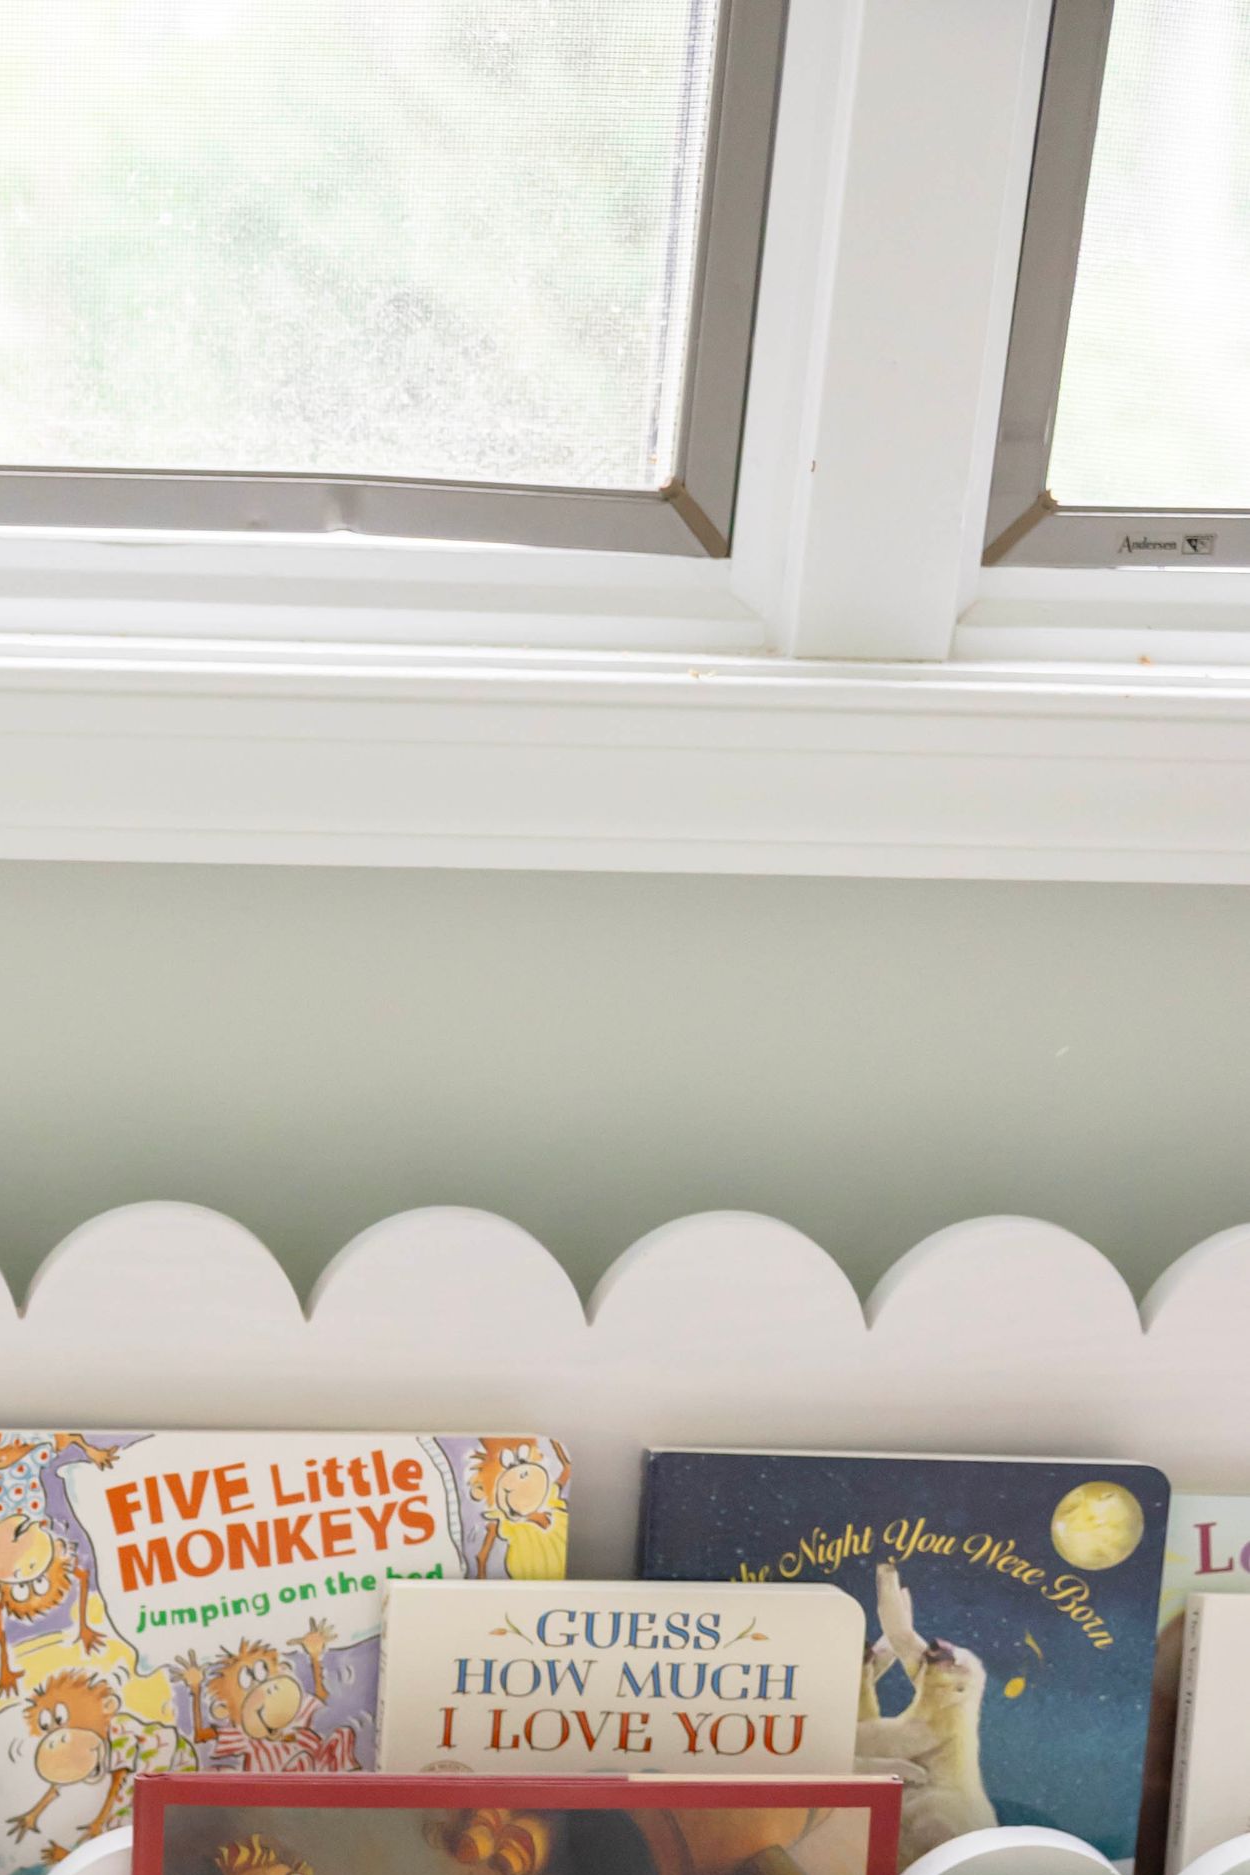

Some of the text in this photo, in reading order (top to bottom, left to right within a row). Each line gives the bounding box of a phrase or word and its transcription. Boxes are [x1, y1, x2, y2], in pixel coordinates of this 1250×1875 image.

[1117, 535, 1177, 554] Andersen
[104, 1450, 424, 1536] FIVE Little
[116, 1494, 436, 1593] MONKEYS
[134, 1588, 271, 1633] jumping
[279, 1581, 317, 1604] on
[324, 1569, 377, 1596] the
[779, 1524, 874, 1579] Night
[883, 1517, 956, 1565] You
[963, 1532, 1047, 1586] Were
[1040, 1573, 1115, 1650] Born
[535, 1608, 722, 1651] GUESS
[451, 1657, 799, 1702] HOW MUCH
[436, 1705, 808, 1756] I LOVE YOU
